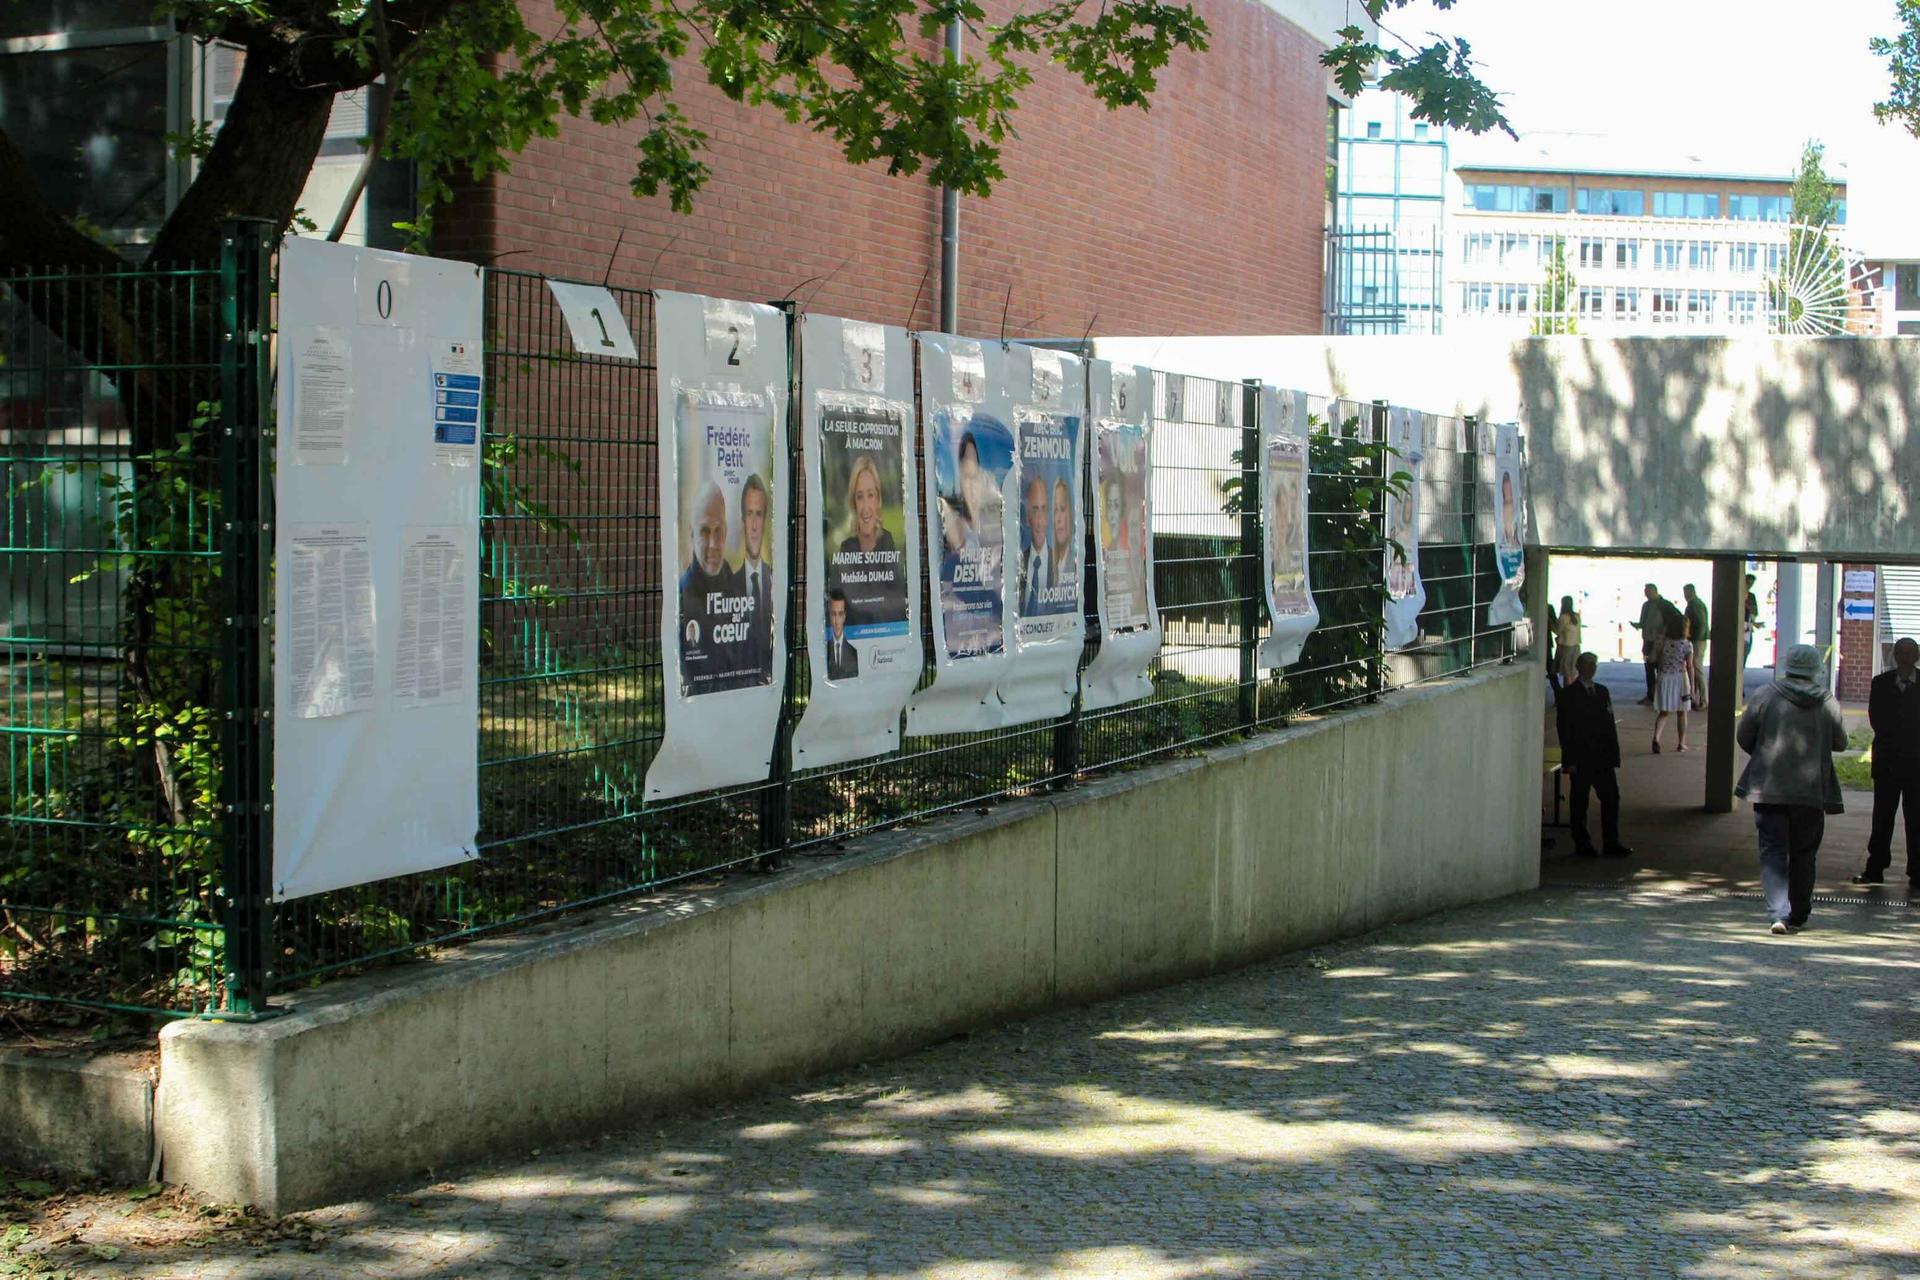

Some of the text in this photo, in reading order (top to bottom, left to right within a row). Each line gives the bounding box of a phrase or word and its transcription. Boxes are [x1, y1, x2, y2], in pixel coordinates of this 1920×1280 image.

[377, 280, 392, 320] 0
[591, 307, 616, 348] 1
[728, 326, 740, 366] 2
[862, 347, 873, 384] 3
[963, 371, 973, 395] 4
[1120, 382, 1126, 410] 6
[1170, 391, 1177, 419] 7
[707, 426, 750, 447] Frédéric
[824, 421, 899, 436] LA SEULE OPPOSITION
[845, 435, 883, 450] À MACRON
[1023, 435, 1071, 460] ZEMMOUR
[717, 448, 744, 468] Petit
[832, 551, 900, 565] MARINE SOUTIENT
[869, 570, 894, 582] DUMAS
[706, 592, 755, 617] l'Europe
[732, 613, 741, 622] au
[713, 622, 750, 644] cœur
